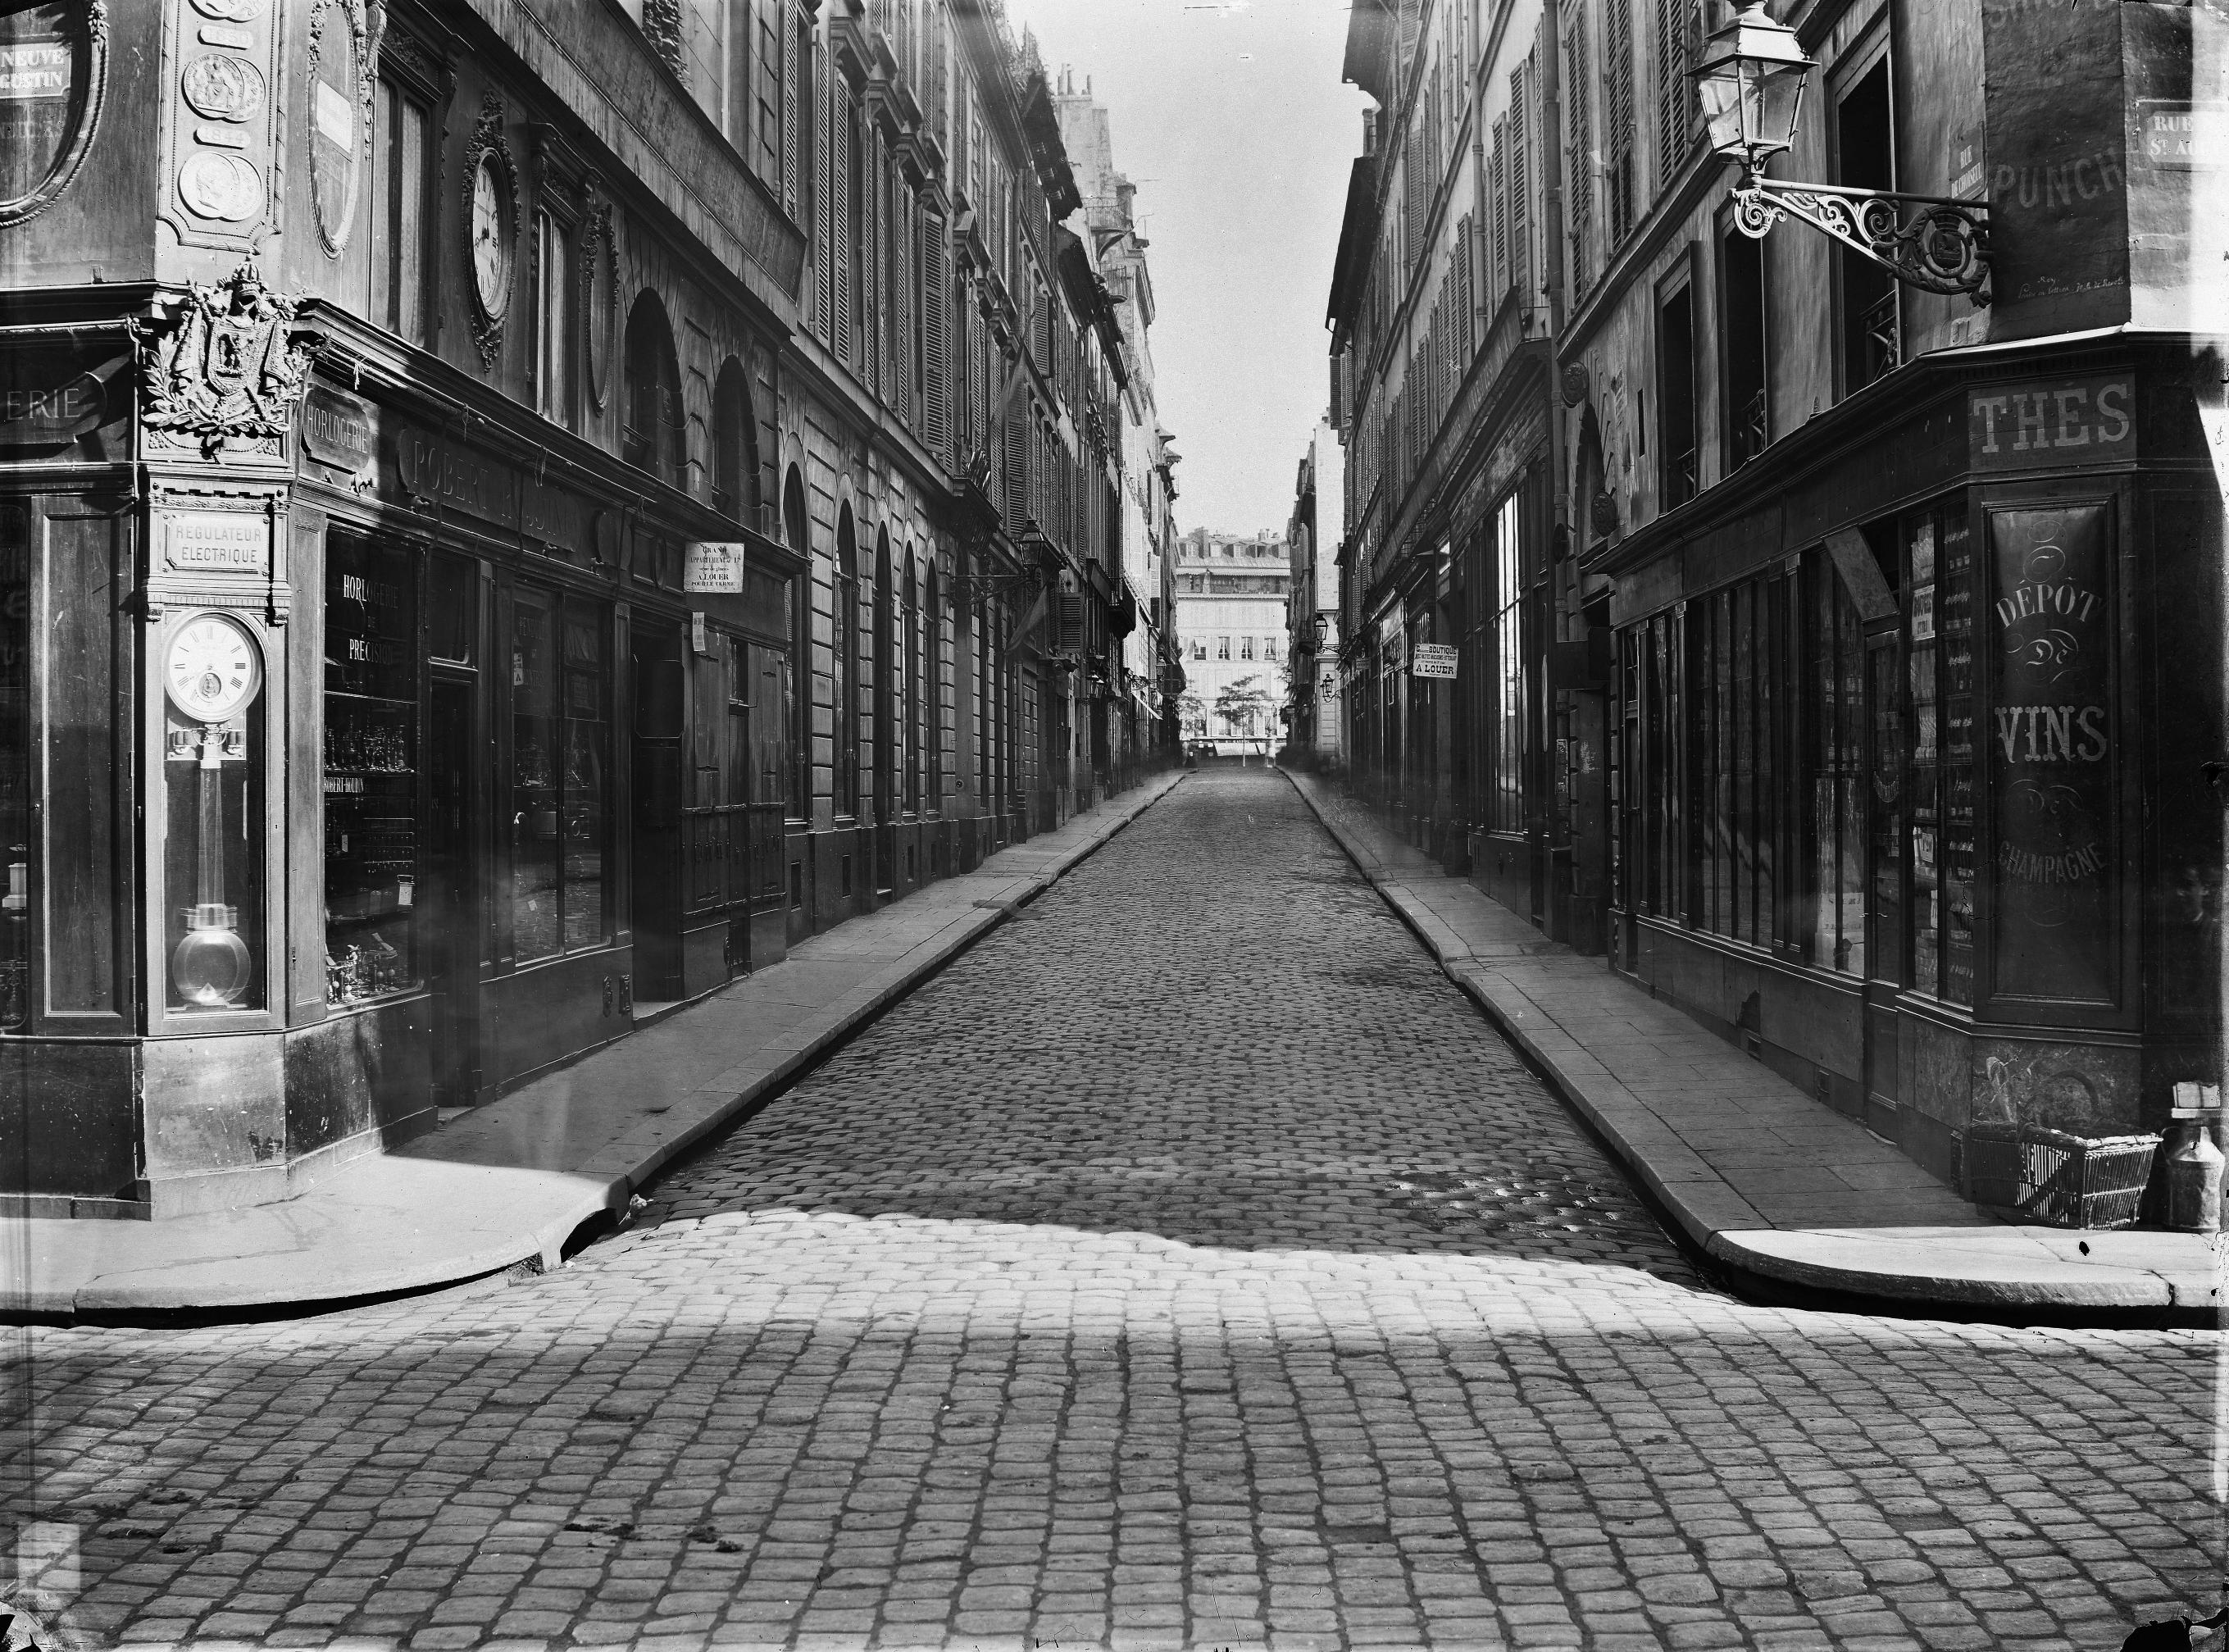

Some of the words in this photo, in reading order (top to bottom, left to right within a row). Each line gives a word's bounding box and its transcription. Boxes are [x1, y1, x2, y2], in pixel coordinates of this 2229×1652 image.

[2, 49, 66, 66] NEUVE
[1960, 145, 1972, 169] RUE
[1993, 148, 2125, 208] PUNCH
[307, 404, 368, 454] HORLOGERIE
[343, 574, 400, 609] HORLOGERIE
[1995, 576, 2104, 629] DÉPÔT
[348, 634, 393, 665] PRÉCISION
[1429, 645, 1457, 654] BOUTIQUE
[1416, 663, 1422, 672] A
[1425, 664, 1454, 675] LOUER
[1994, 705, 2108, 763] VINS
[1999, 840, 2105, 884] CHAMPAGNE
